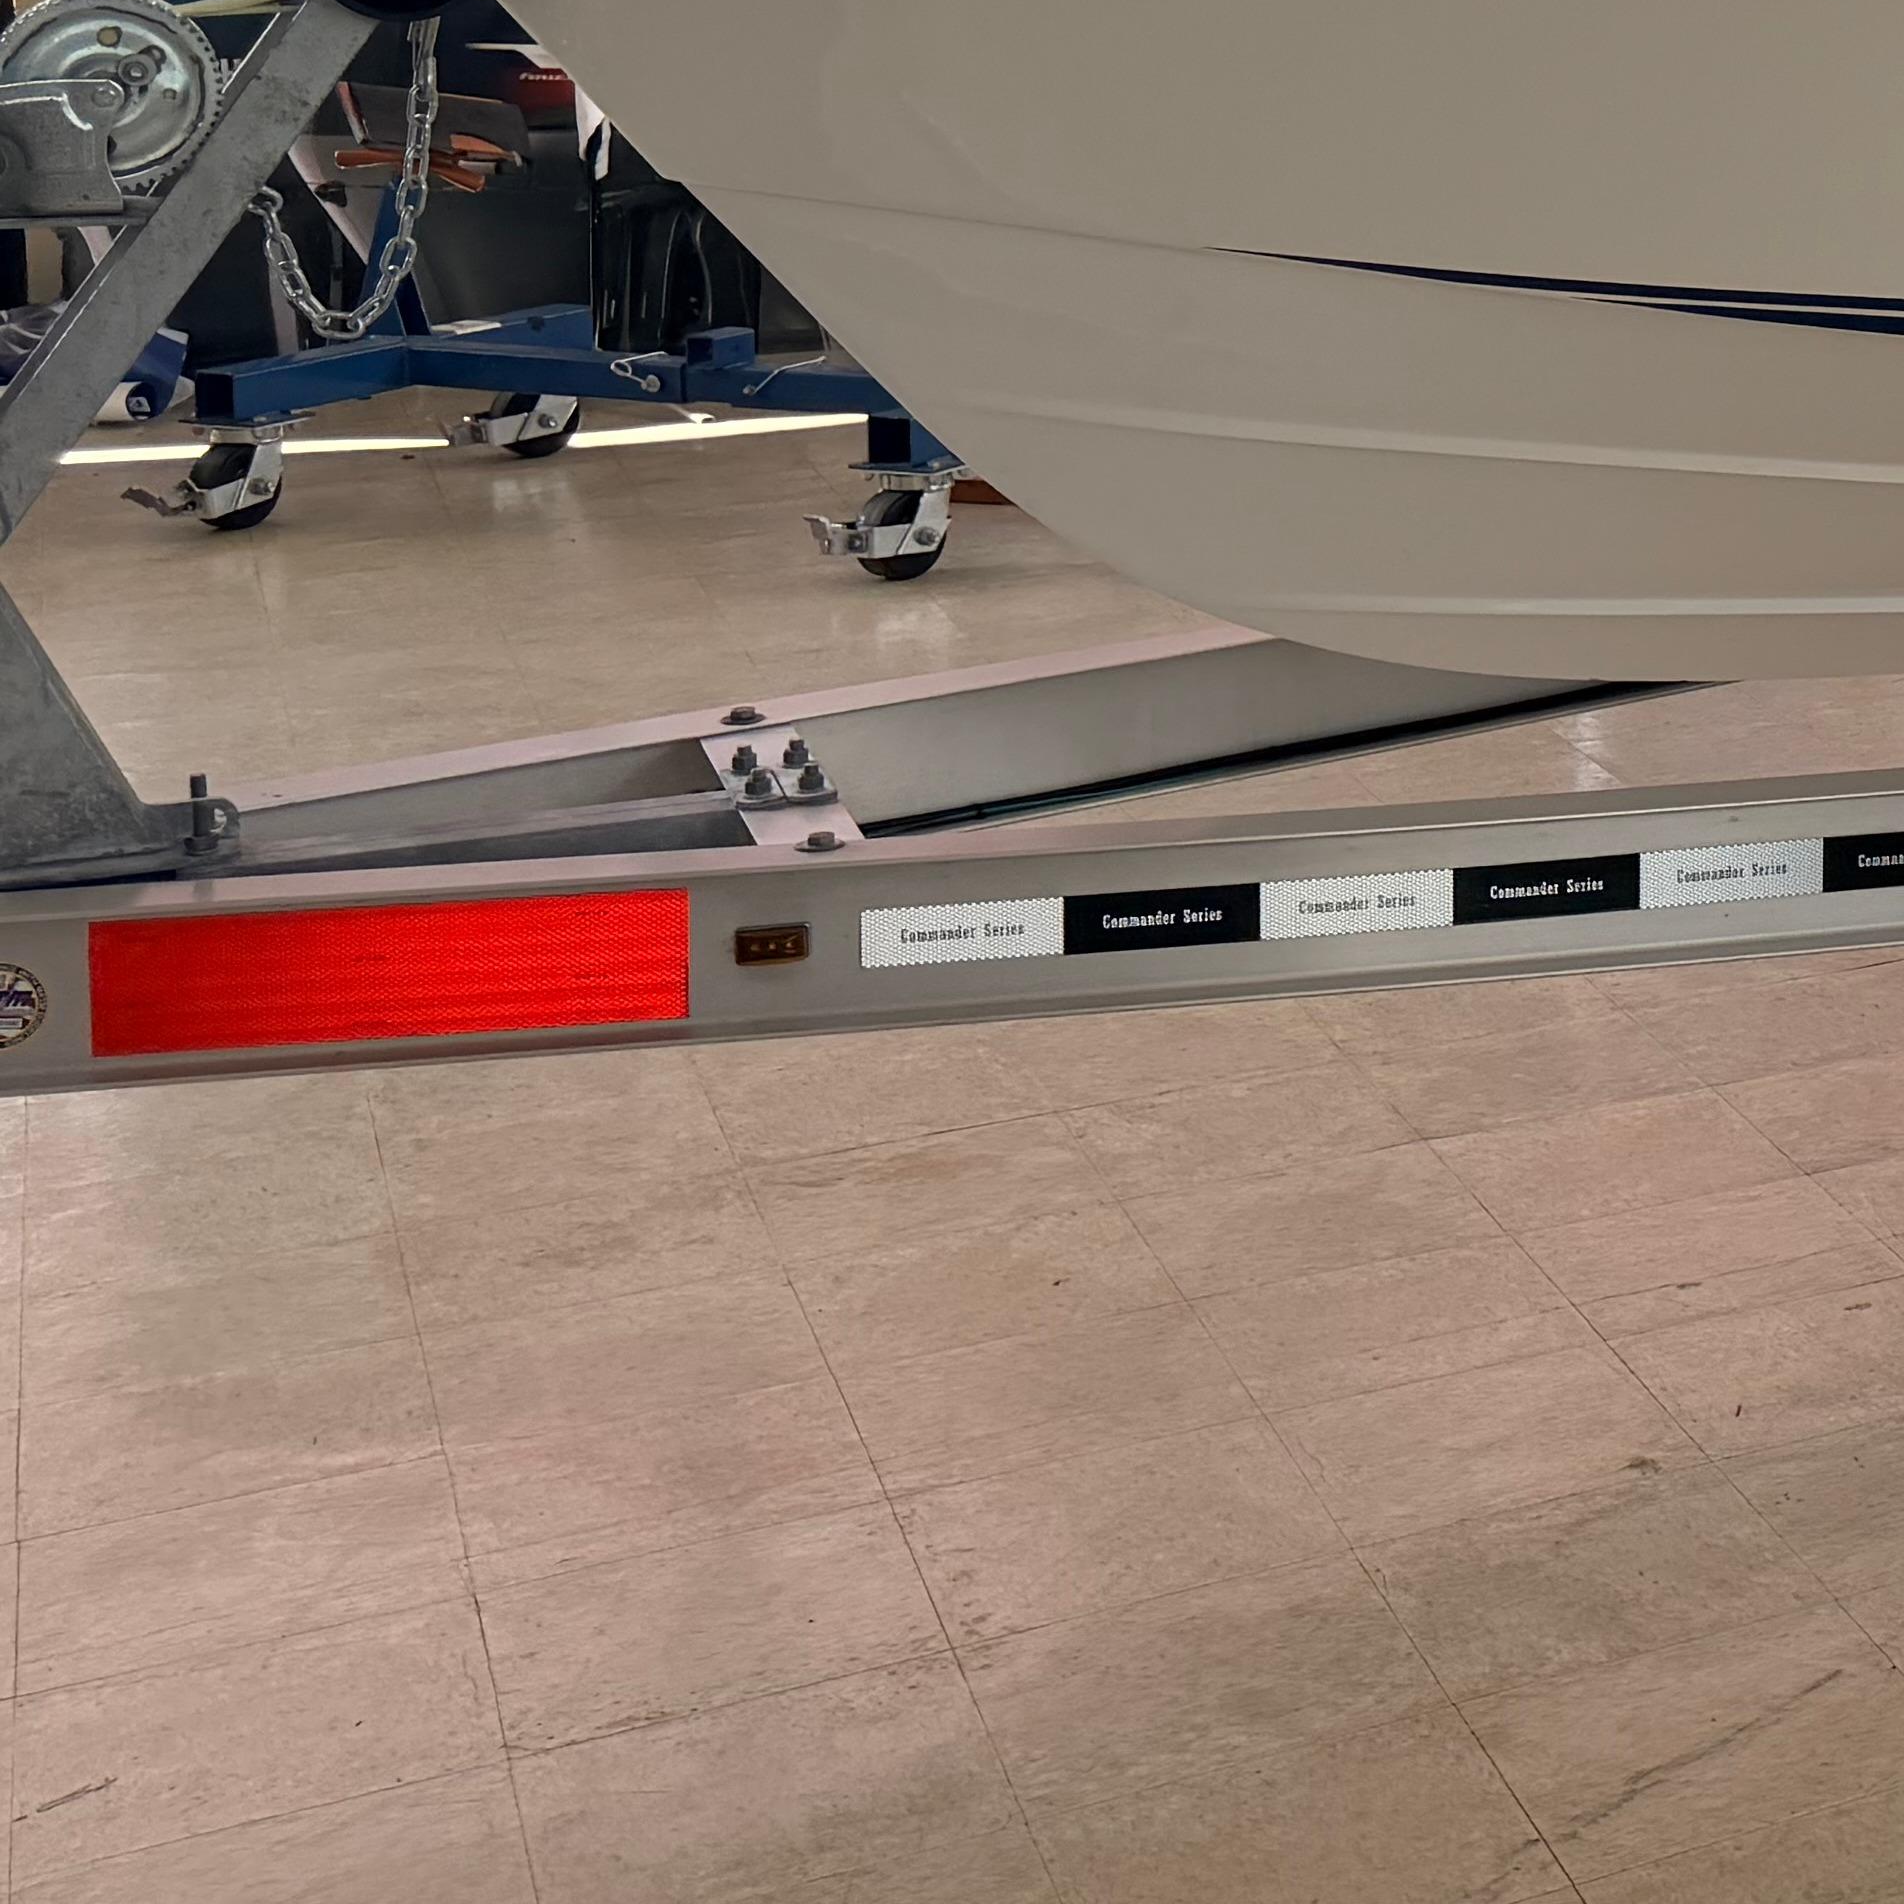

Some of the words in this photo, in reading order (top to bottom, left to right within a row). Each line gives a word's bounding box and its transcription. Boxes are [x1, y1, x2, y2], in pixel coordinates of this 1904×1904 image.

[1489, 881, 1560, 901] Commander
[1566, 878, 1605, 895] Series
[1102, 908, 1176, 931] Commander
[1183, 907, 1224, 924] Series
